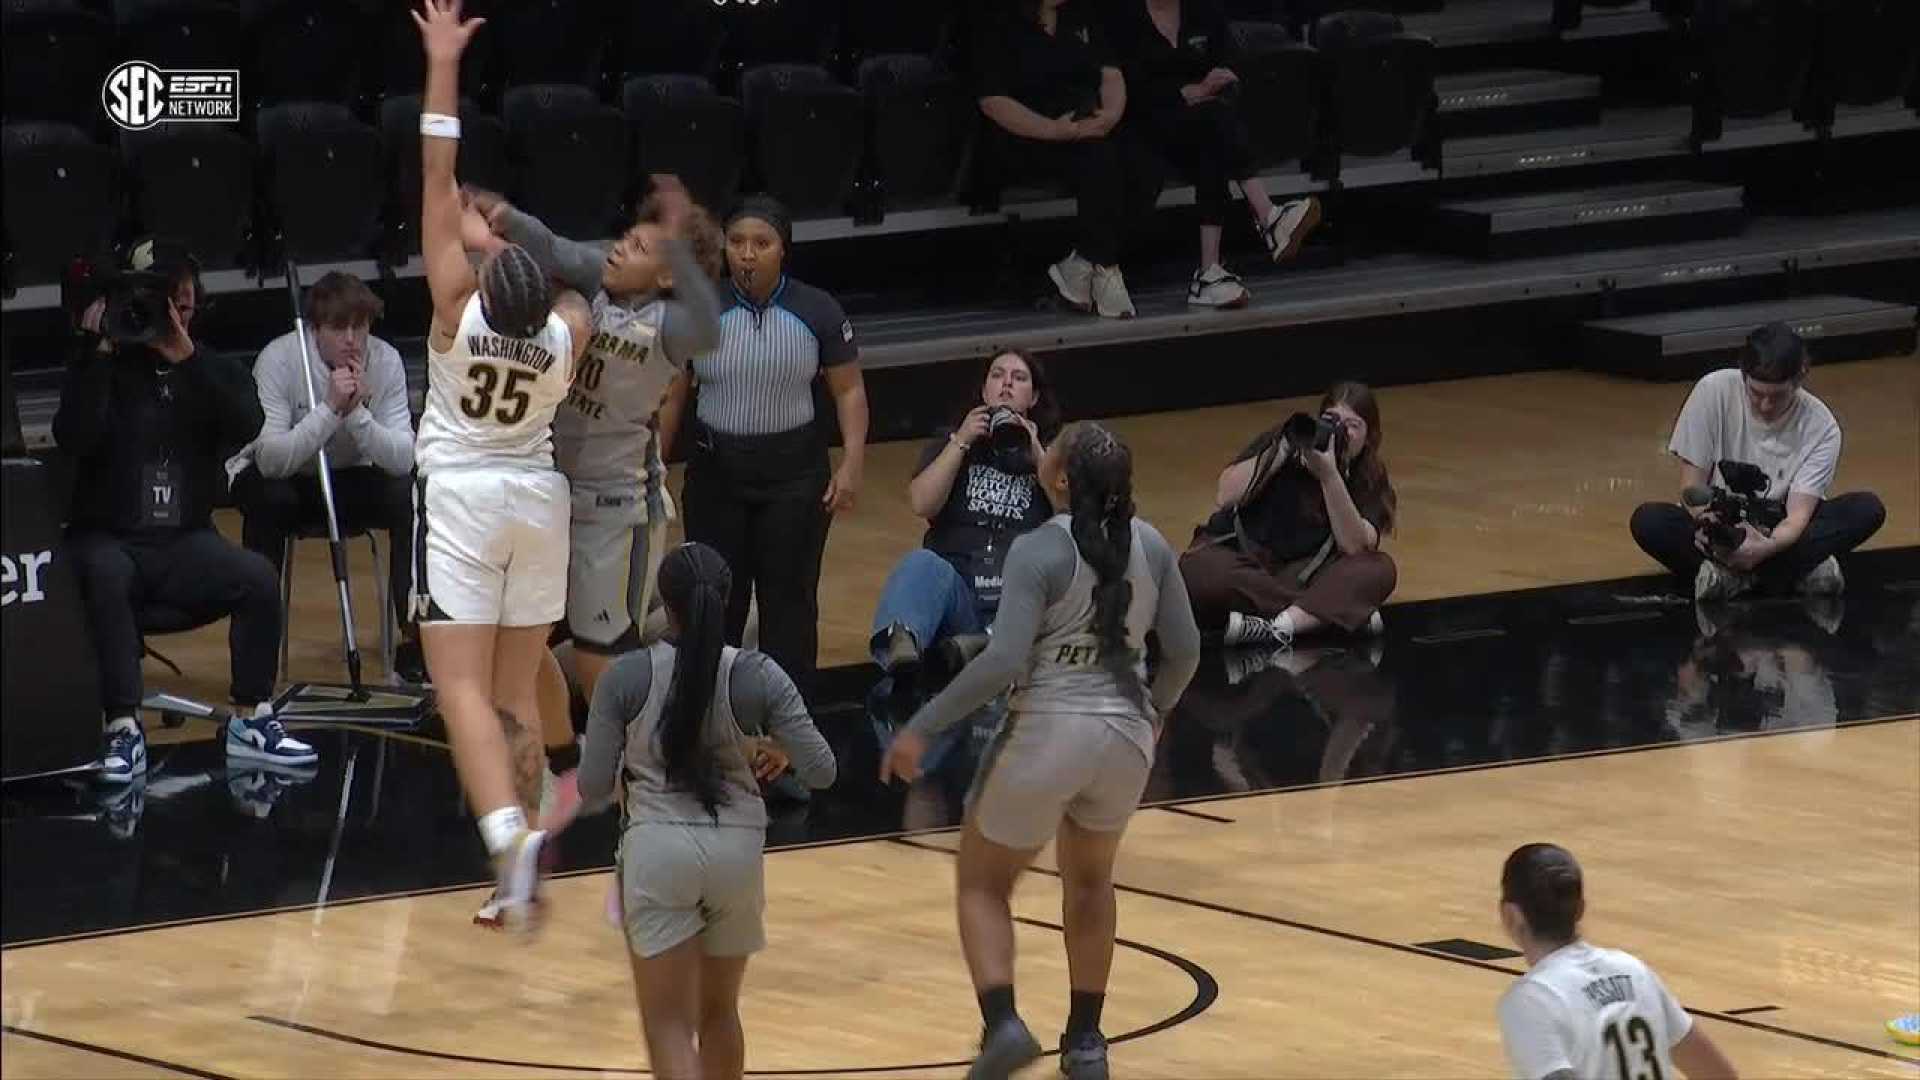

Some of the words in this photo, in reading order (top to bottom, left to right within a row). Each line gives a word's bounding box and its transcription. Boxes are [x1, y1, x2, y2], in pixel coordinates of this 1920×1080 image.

[468, 335, 556, 374] WASHINGTON
[460, 362, 538, 425] 35
[152, 486, 172, 504] TV
[968, 475, 1033, 503] WATCHES
[1603, 1016, 1663, 1080] 13
